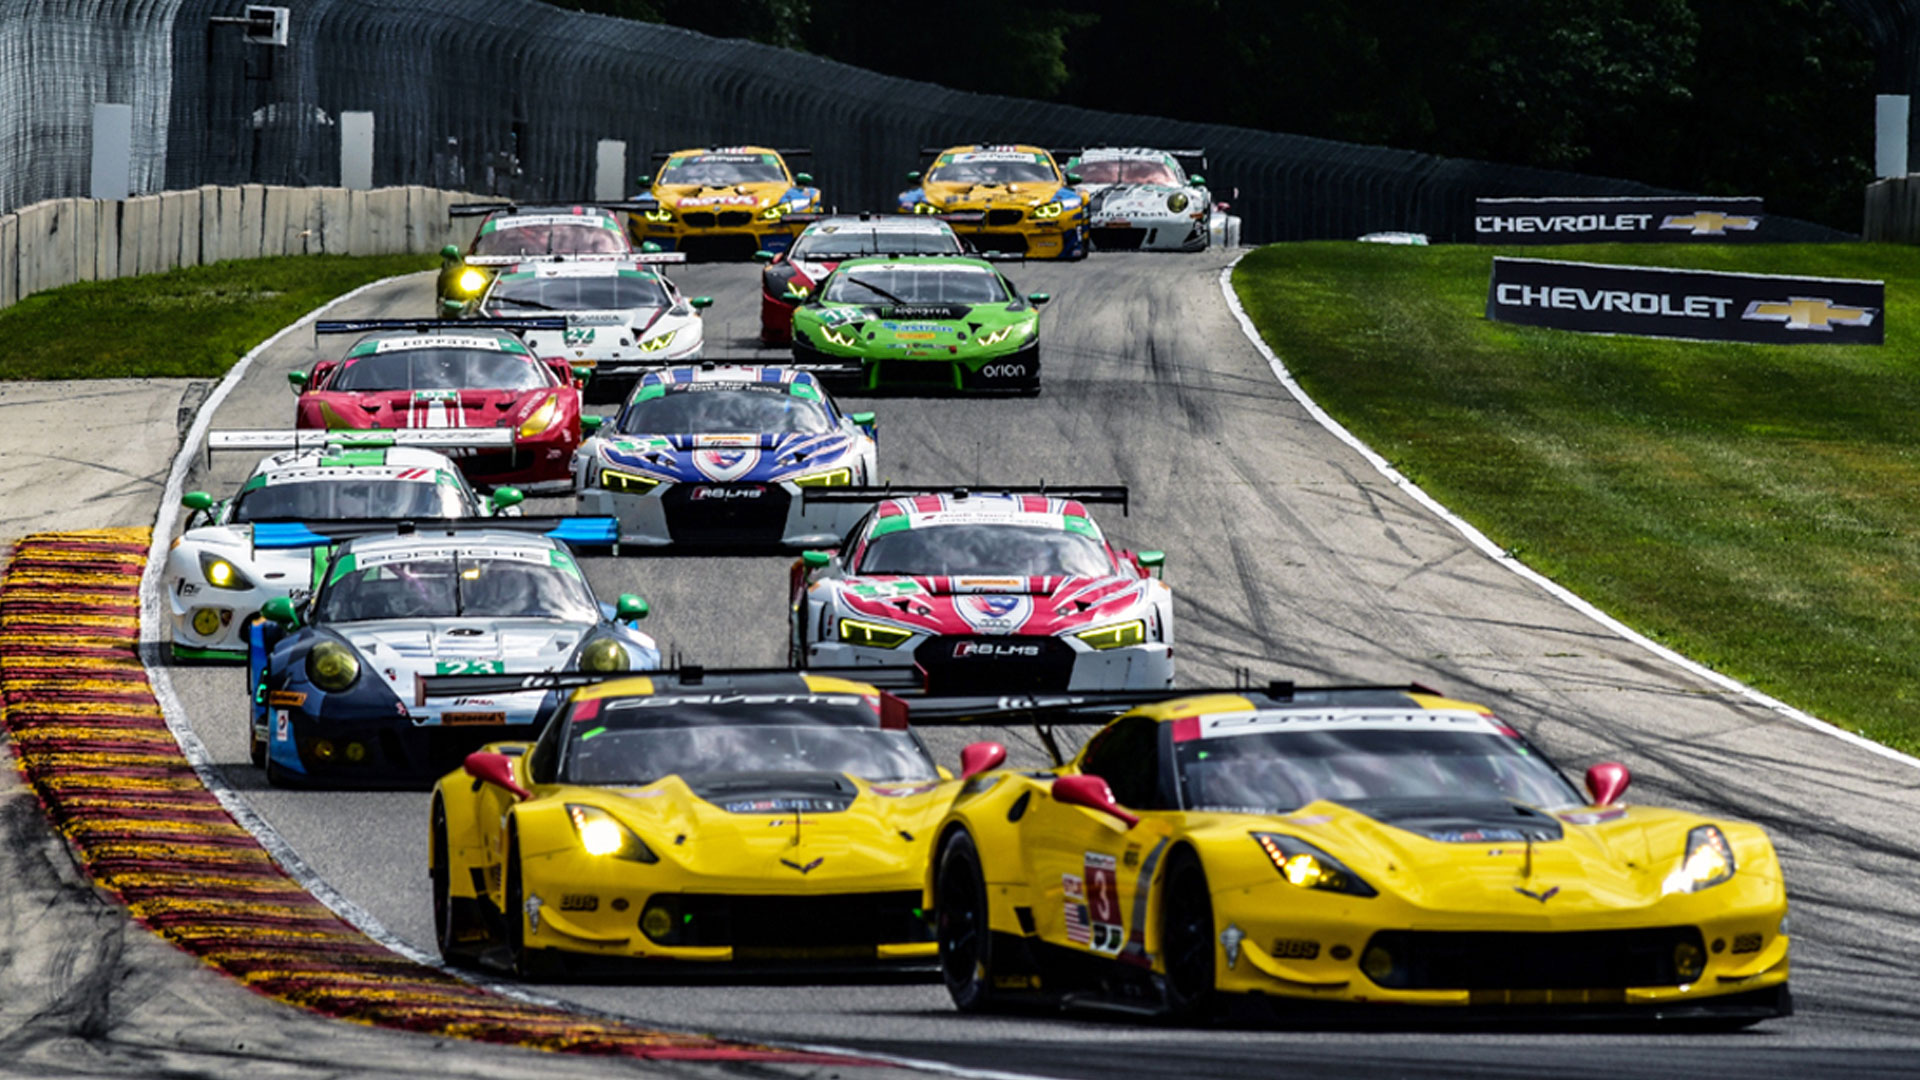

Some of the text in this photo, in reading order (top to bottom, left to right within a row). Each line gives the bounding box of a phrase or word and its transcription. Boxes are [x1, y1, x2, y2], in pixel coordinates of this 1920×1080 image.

[1475, 214, 1653, 233] CHEVROLET
[1496, 283, 1733, 318] CHEVROLET
[895, 307, 951, 316] MONSTER
[566, 327, 594, 341] 27
[983, 364, 1026, 378] orion
[361, 549, 544, 566] PORSCHE
[444, 660, 497, 675] 23
[604, 694, 860, 711] CORVETTE
[1210, 713, 1479, 729] CORVETTE
[1094, 870, 1111, 922] 3
[1272, 938, 1320, 960] BBS
